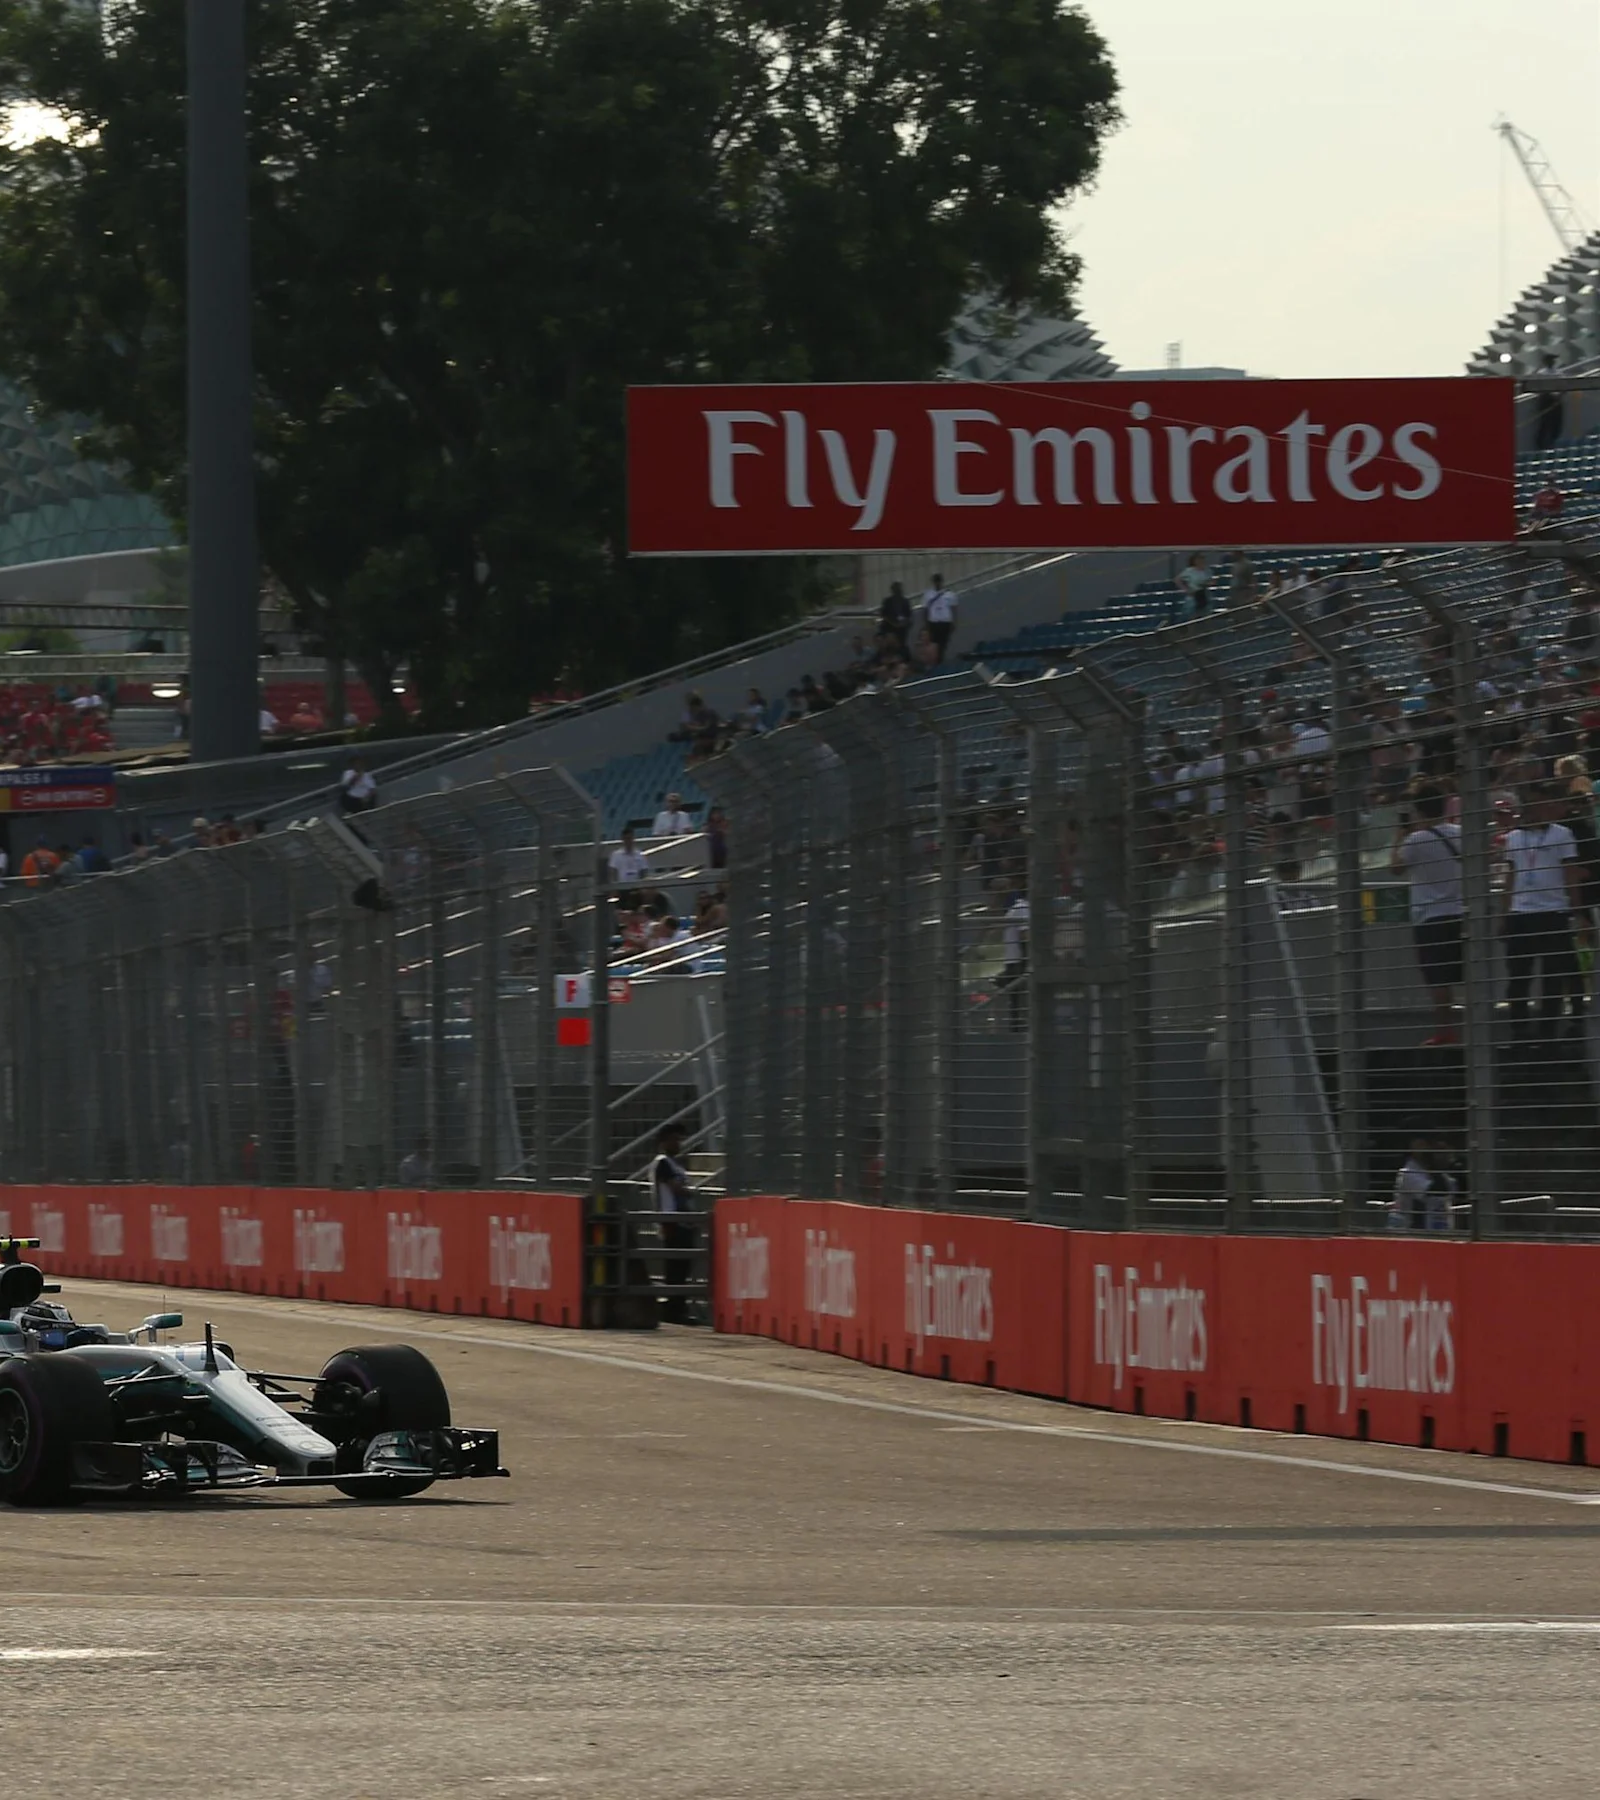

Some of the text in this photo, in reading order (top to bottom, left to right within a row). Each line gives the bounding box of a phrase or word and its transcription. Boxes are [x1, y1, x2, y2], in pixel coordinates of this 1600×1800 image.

[704, 401, 1443, 531] Fly Emirates
[565, 979, 578, 1003] F
[1094, 1261, 1207, 1390] Fly Emirates
[1311, 1270, 1455, 1414] Fly Emirates
